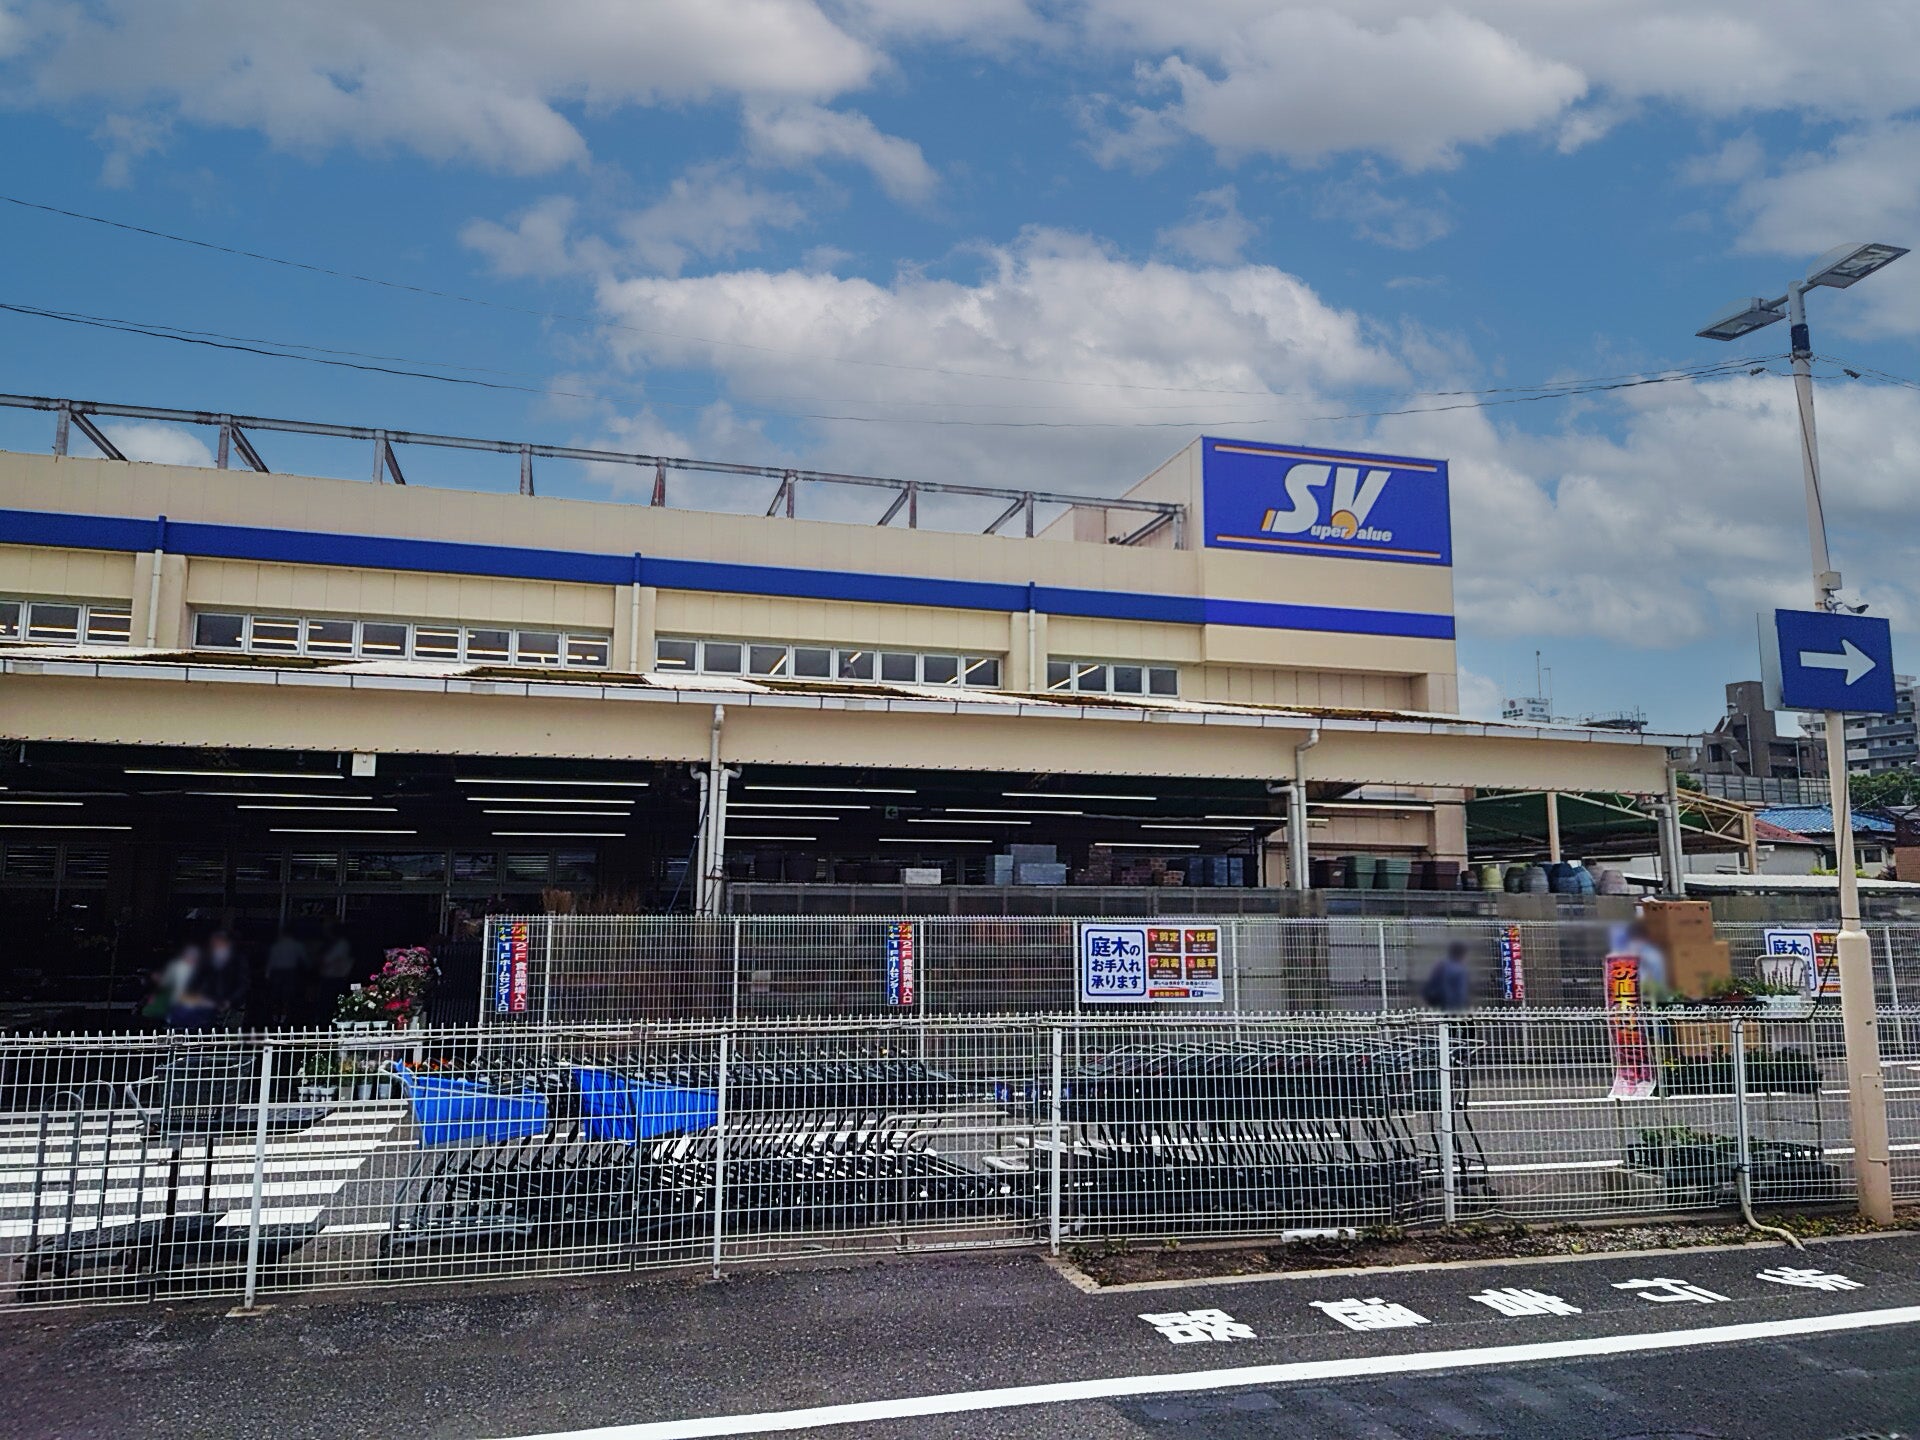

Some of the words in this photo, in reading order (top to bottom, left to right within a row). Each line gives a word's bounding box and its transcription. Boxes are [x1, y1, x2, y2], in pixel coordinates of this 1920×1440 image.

[1262, 463, 1392, 534] SV
[1091, 936, 1141, 958] 庭木の
[1773, 939, 1811, 956] 庭木の
[1091, 958, 1142, 974] お手入れ
[1091, 974, 1142, 989] 承ります
